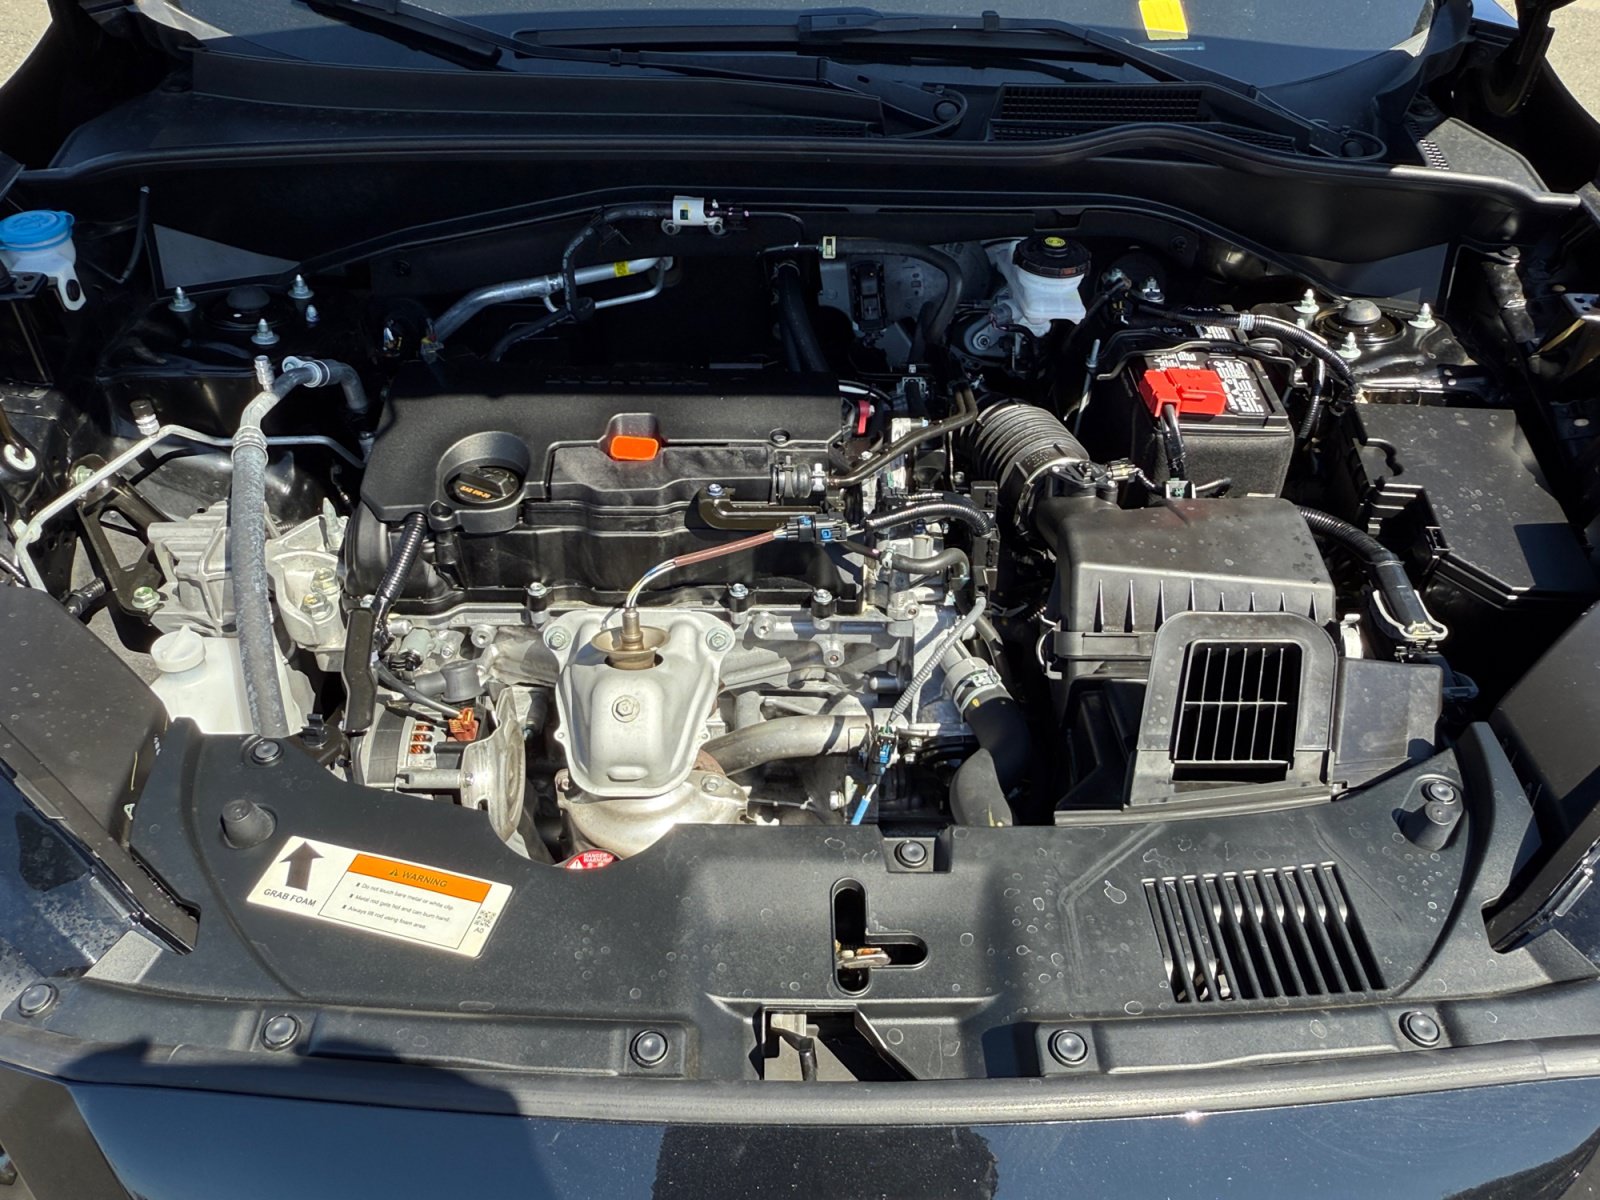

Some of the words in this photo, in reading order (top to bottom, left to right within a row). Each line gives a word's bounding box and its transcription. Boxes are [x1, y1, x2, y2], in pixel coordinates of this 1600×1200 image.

[402, 871, 448, 888] WARNING
[263, 888, 290, 900] GRAB
[289, 894, 317, 907] FOAM
[355, 894, 370, 902] Metal
[379, 901, 391, 909] gets
[392, 902, 401, 910] hot
[406, 894, 422, 902] metal
[428, 900, 444, 908] white
[347, 905, 367, 915] Always
[384, 915, 399, 924] using
[399, 918, 413, 926] foam
